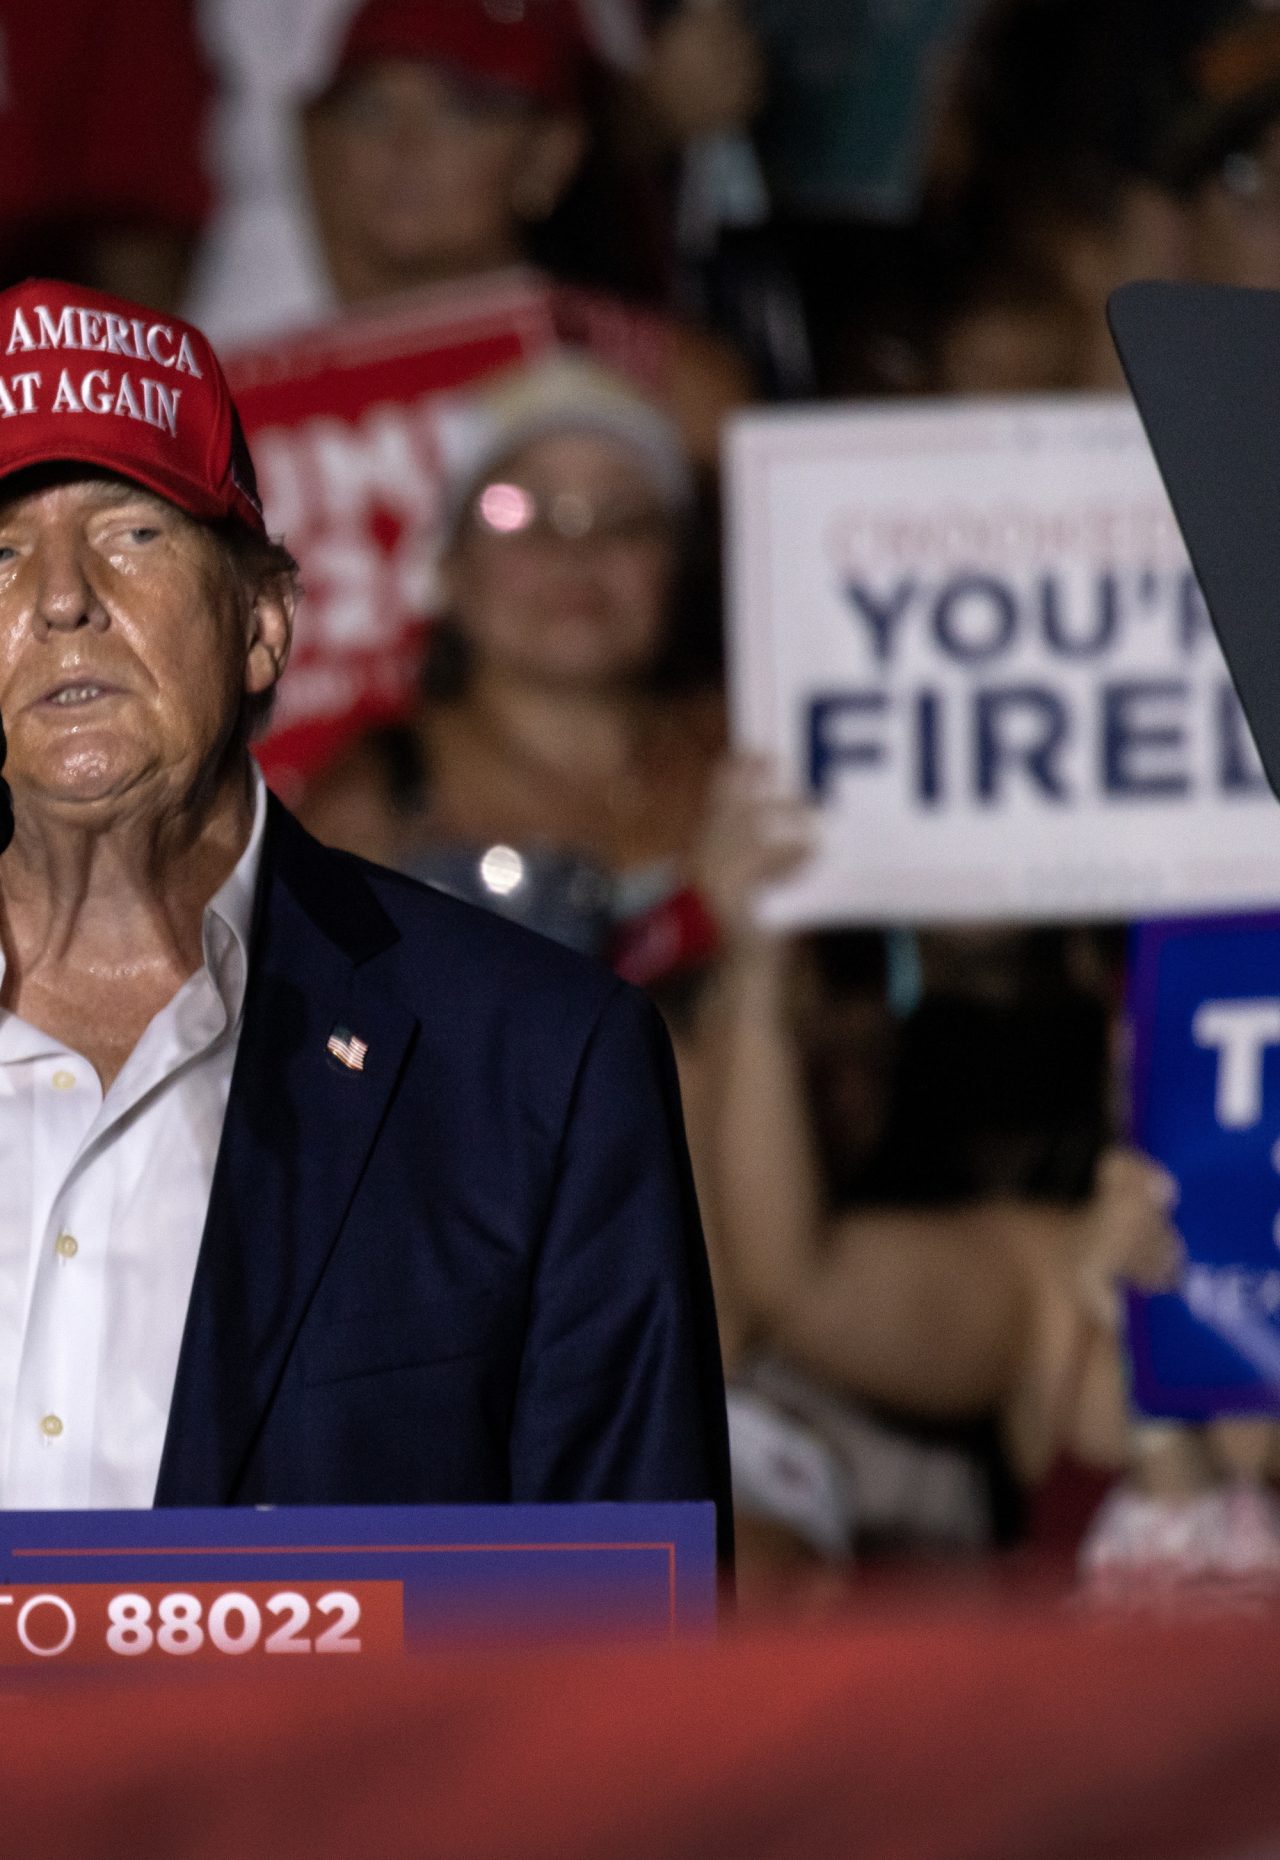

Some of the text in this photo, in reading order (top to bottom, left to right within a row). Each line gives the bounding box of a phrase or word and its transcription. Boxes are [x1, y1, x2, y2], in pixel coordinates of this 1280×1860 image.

[5, 305, 203, 379] AMERICA
[52, 368, 181, 438] AGAIN
[106, 1591, 362, 1656] 88022
